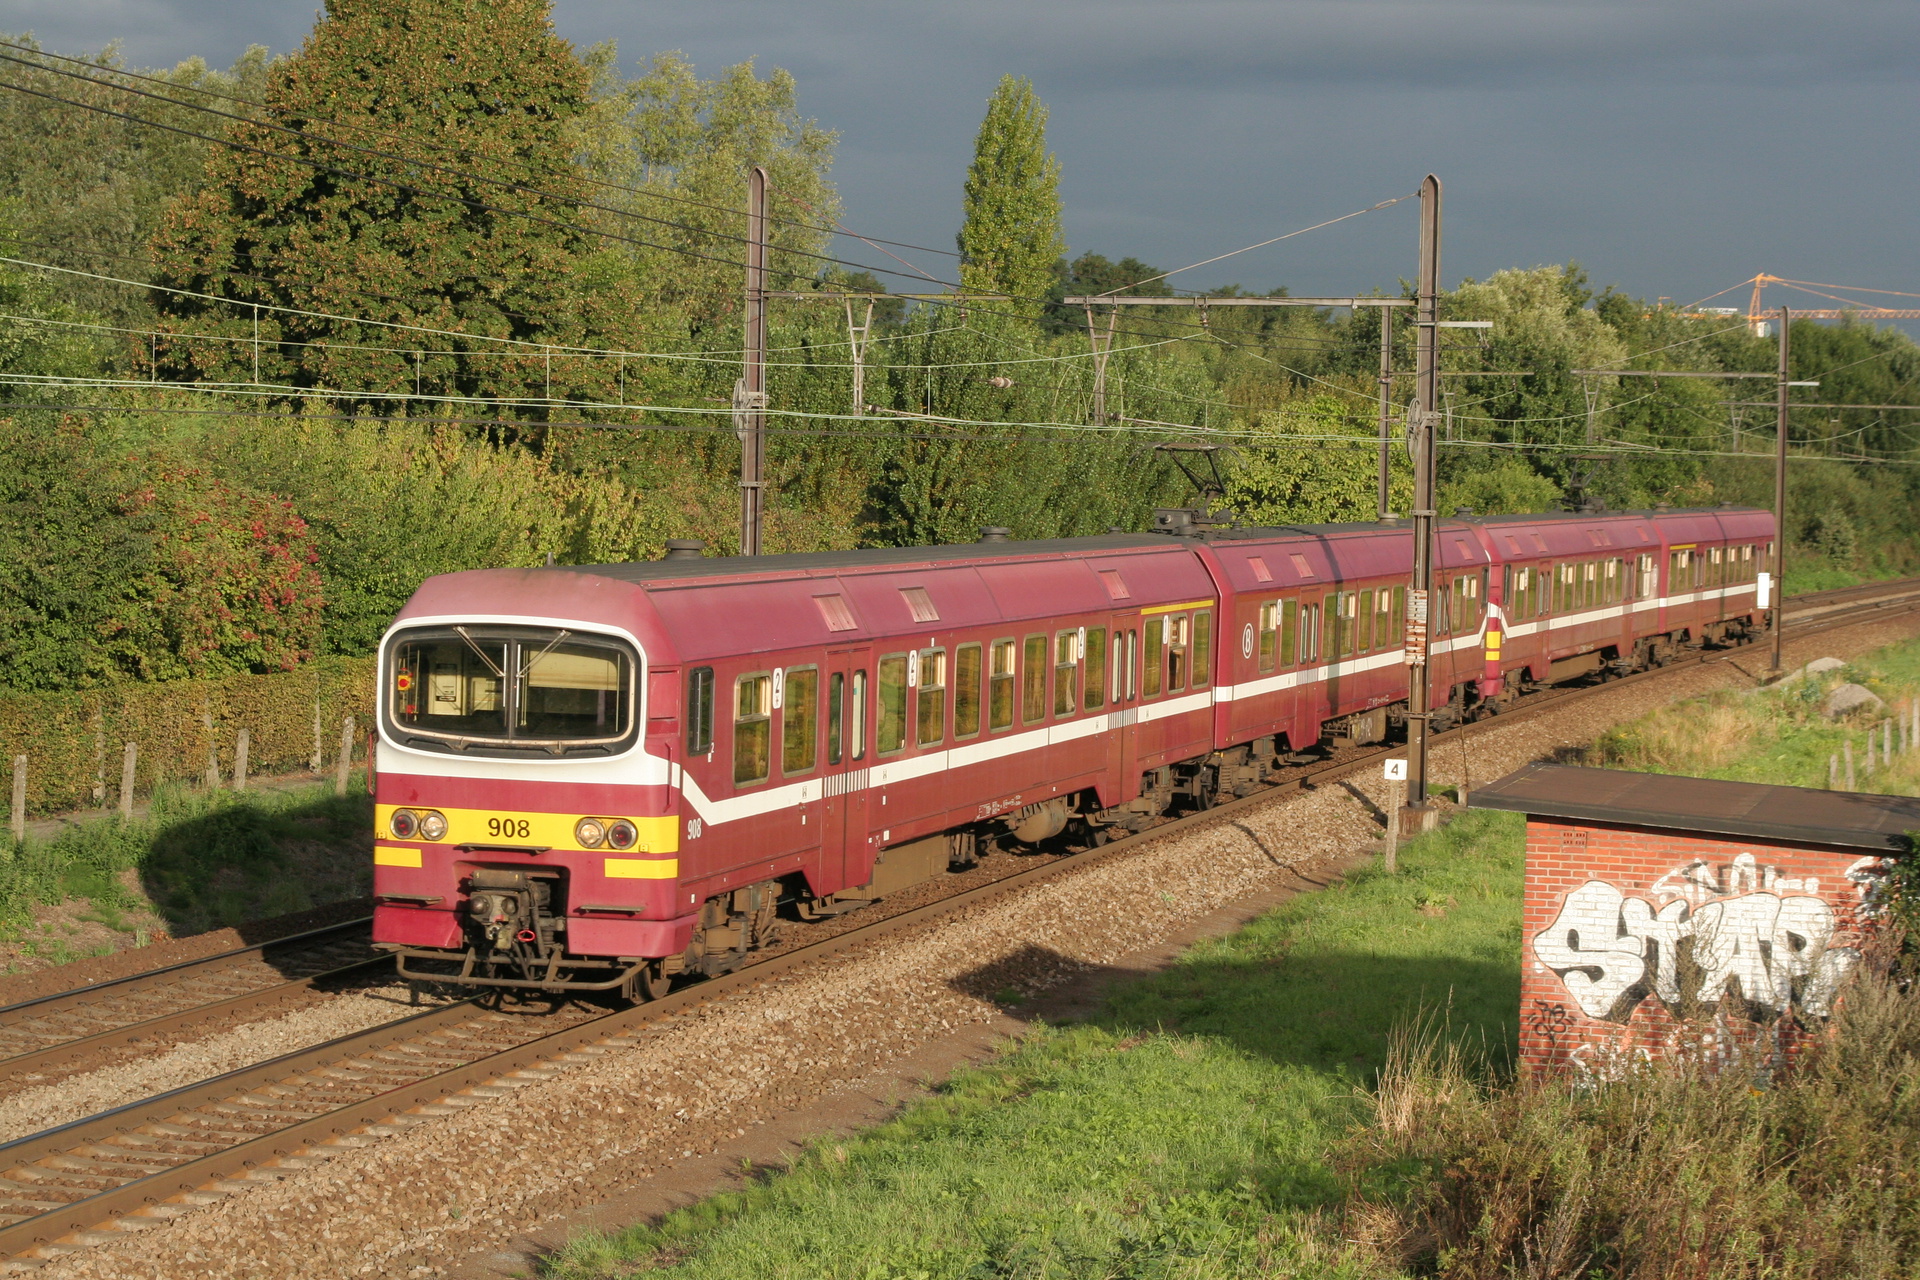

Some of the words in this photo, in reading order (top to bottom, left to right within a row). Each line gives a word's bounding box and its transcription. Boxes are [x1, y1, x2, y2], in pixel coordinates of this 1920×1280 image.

[1078, 630, 1083, 646] 2
[911, 653, 916, 674] 2
[774, 672, 780, 694] 2
[1390, 763, 1399, 776] 4
[488, 817, 531, 838] 908
[687, 817, 702, 840] 908
